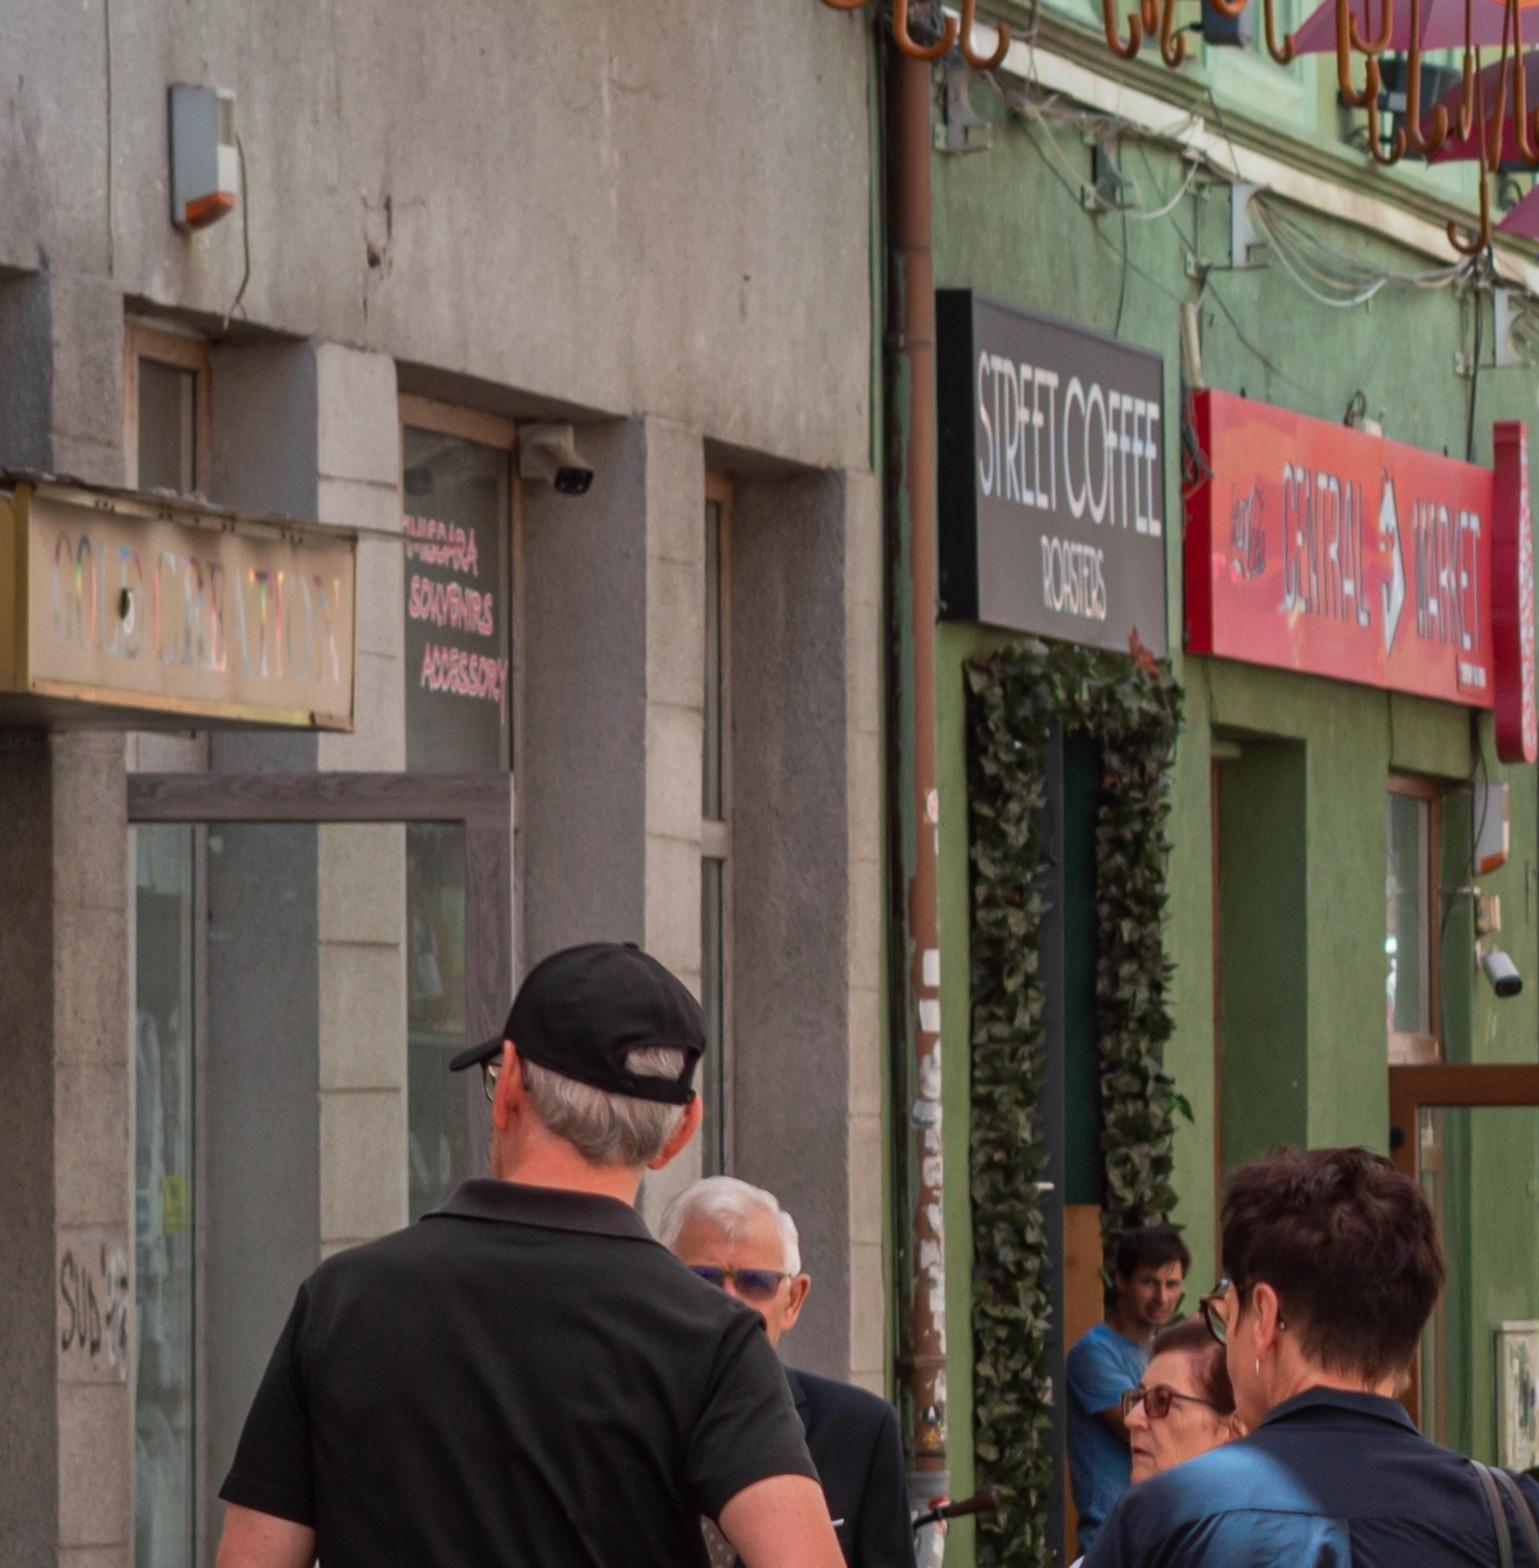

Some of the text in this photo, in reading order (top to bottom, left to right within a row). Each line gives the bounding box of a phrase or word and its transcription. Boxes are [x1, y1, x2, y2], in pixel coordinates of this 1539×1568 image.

[978, 350, 1059, 512] STREET
[1063, 376, 1162, 538] COFFEE
[52, 529, 340, 684] GOLD CREATION
[1041, 534, 1107, 622] ROASTERS
[1283, 461, 1370, 627] CENTRAL
[1413, 496, 1481, 654] MARKET
[421, 642, 509, 726] ACCESSORY
